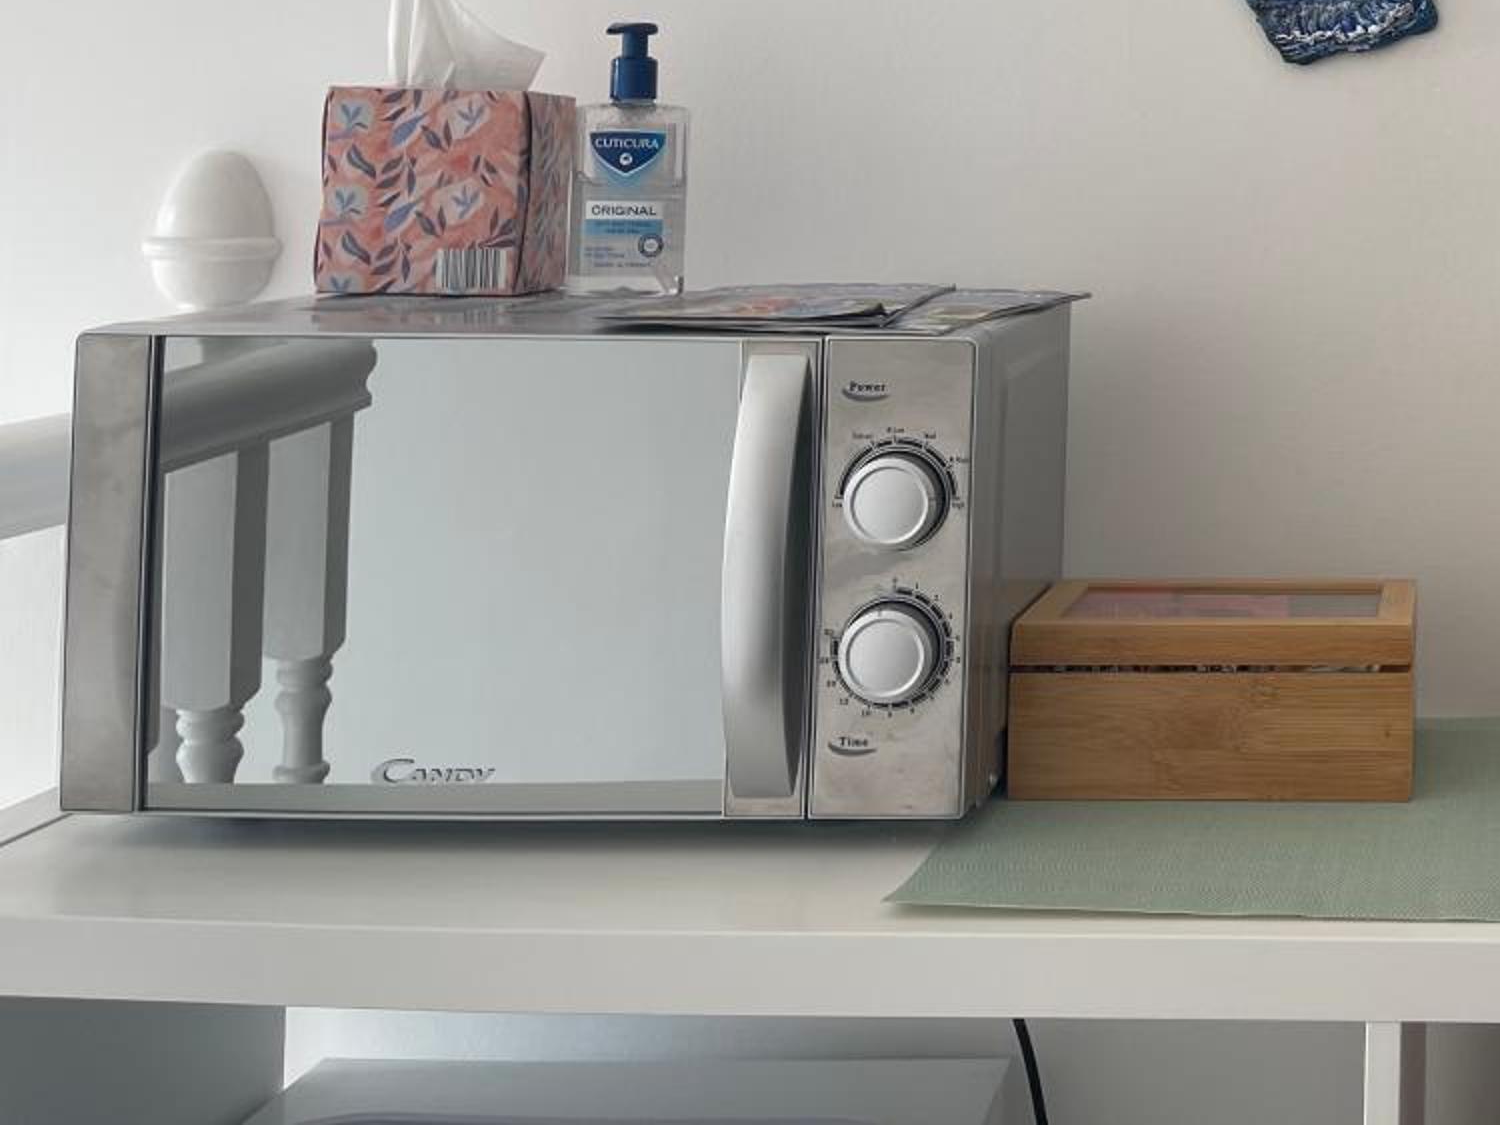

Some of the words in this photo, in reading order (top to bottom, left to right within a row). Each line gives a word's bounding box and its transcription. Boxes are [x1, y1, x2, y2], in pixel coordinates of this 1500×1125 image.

[595, 137, 659, 150] CUTICURA
[591, 204, 657, 216] ORIGINAL
[850, 380, 886, 392] Power
[839, 735, 869, 747] Time
